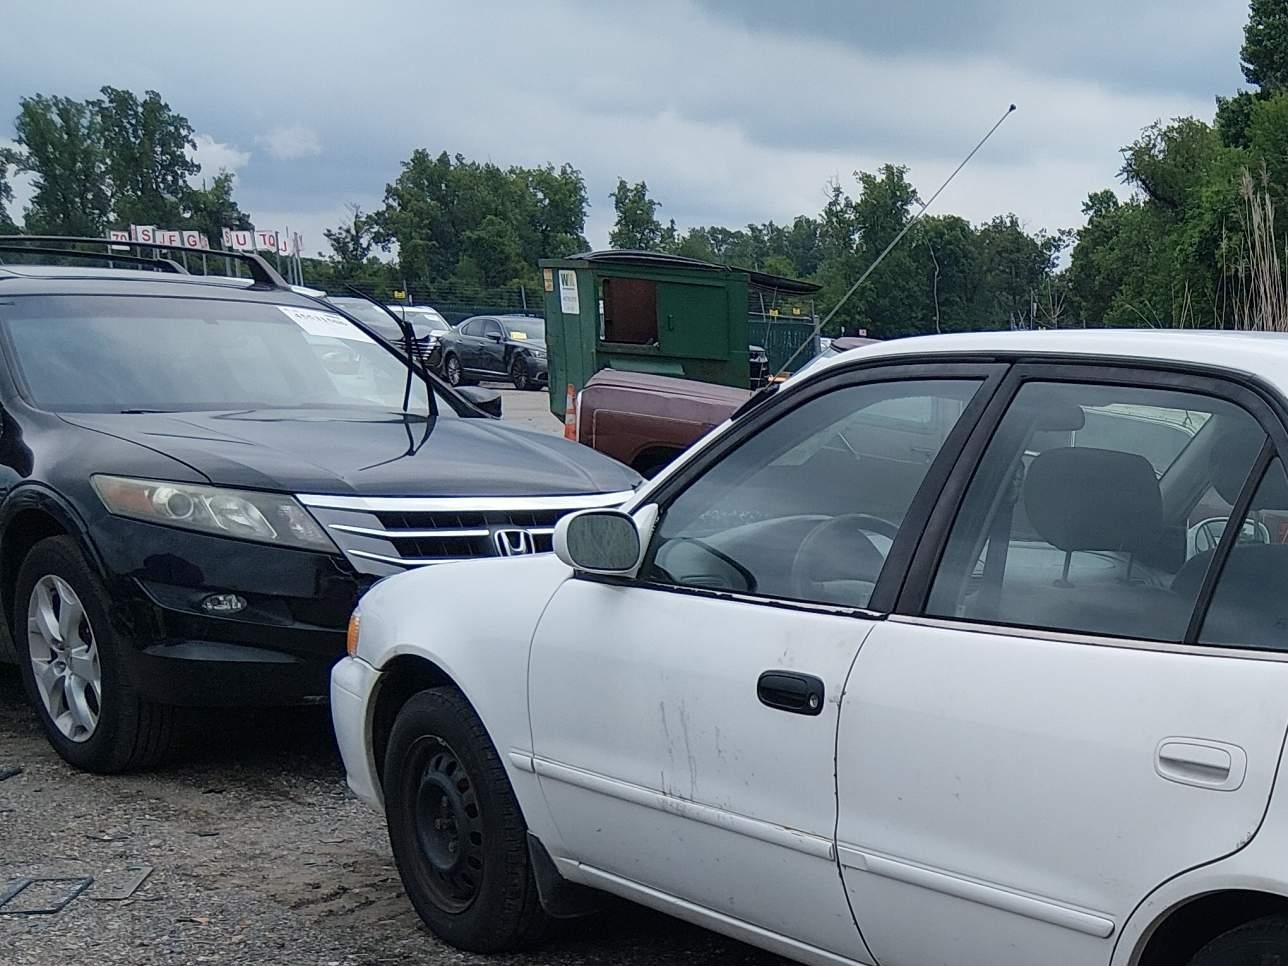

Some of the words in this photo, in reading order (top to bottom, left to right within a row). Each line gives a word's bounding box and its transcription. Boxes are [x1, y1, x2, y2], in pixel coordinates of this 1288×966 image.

[142, 229, 151, 241] S
[187, 234, 197, 247] G
[236, 234, 247, 246] U
